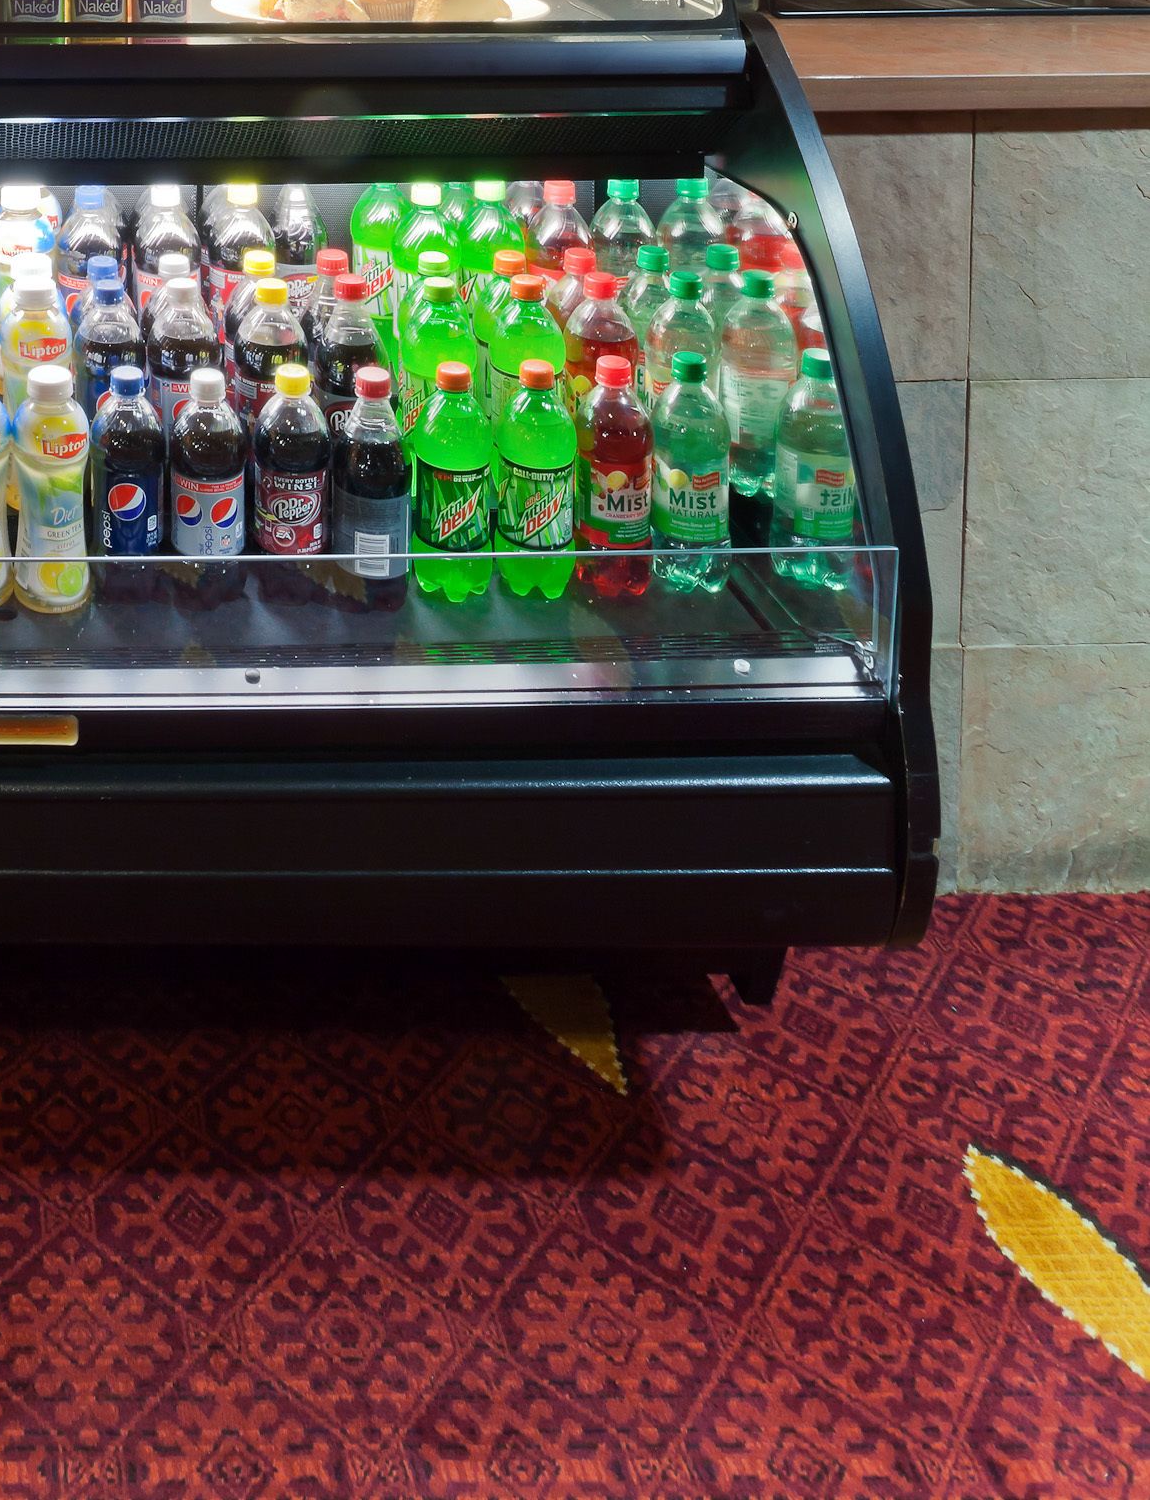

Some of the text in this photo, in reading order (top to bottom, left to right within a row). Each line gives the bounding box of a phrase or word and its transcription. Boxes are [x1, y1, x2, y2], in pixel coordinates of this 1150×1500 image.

[143, 0, 184, 14] Naked
[142, 275, 158, 286] WIN
[23, 341, 66, 359] Lipton
[46, 436, 87, 455] Lipton
[180, 478, 199, 491] WIN
[274, 476, 294, 484] EVERY
[274, 481, 317, 490] WINS!
[289, 498, 304, 508] Dr
[607, 493, 648, 512] Mist
[669, 488, 716, 510] Mist
[52, 506, 77, 526] Diet
[278, 500, 312, 520] Pepper
[669, 508, 718, 519] NATURAL
[47, 523, 82, 538] GREEN TEA
[103, 511, 113, 548] pepsi
[276, 530, 292, 540] EA
[56, 539, 76, 550] citrus
[204, 525, 214, 556] pepsi
